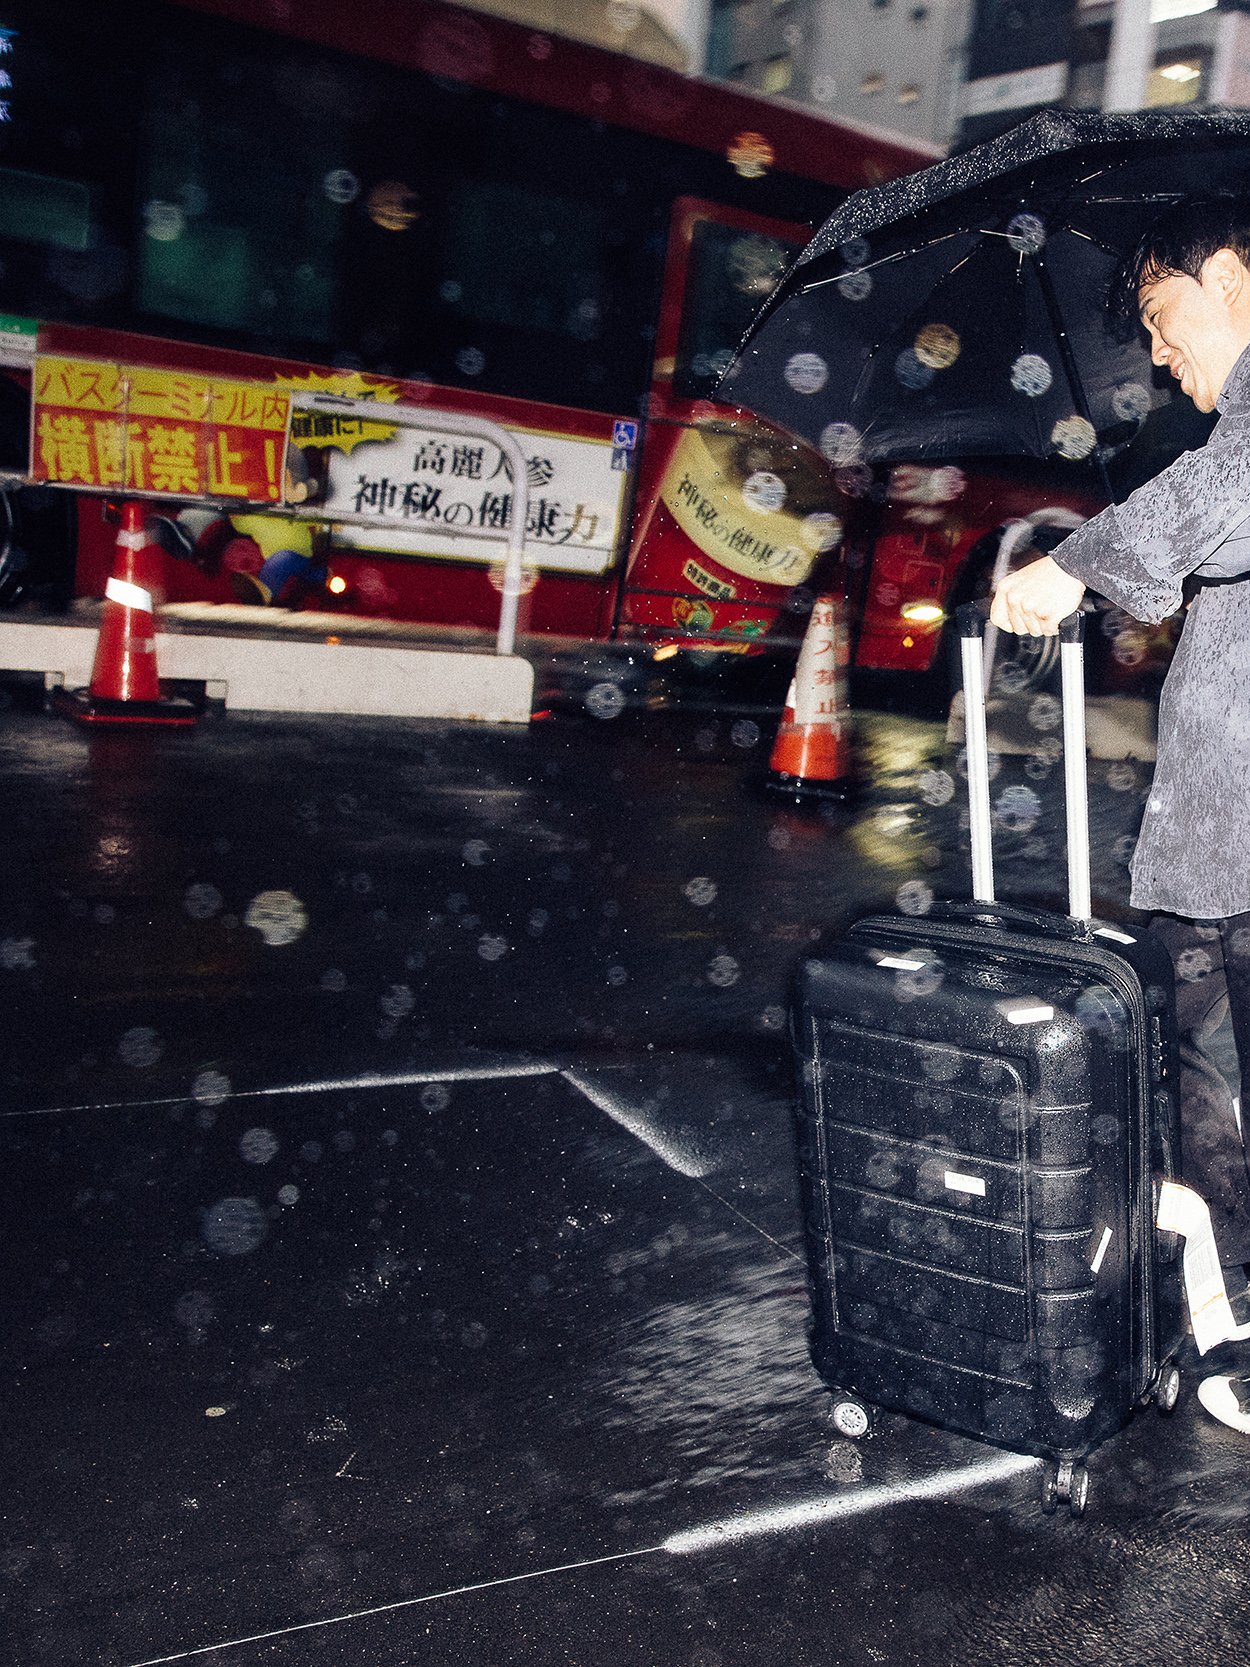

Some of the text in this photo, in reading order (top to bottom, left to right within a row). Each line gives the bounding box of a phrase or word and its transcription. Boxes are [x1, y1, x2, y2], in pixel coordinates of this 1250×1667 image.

[40, 364, 290, 428] バスターミナル内
[413, 440, 553, 488] 高麗人参
[353, 474, 598, 545] 神秘の健康力
